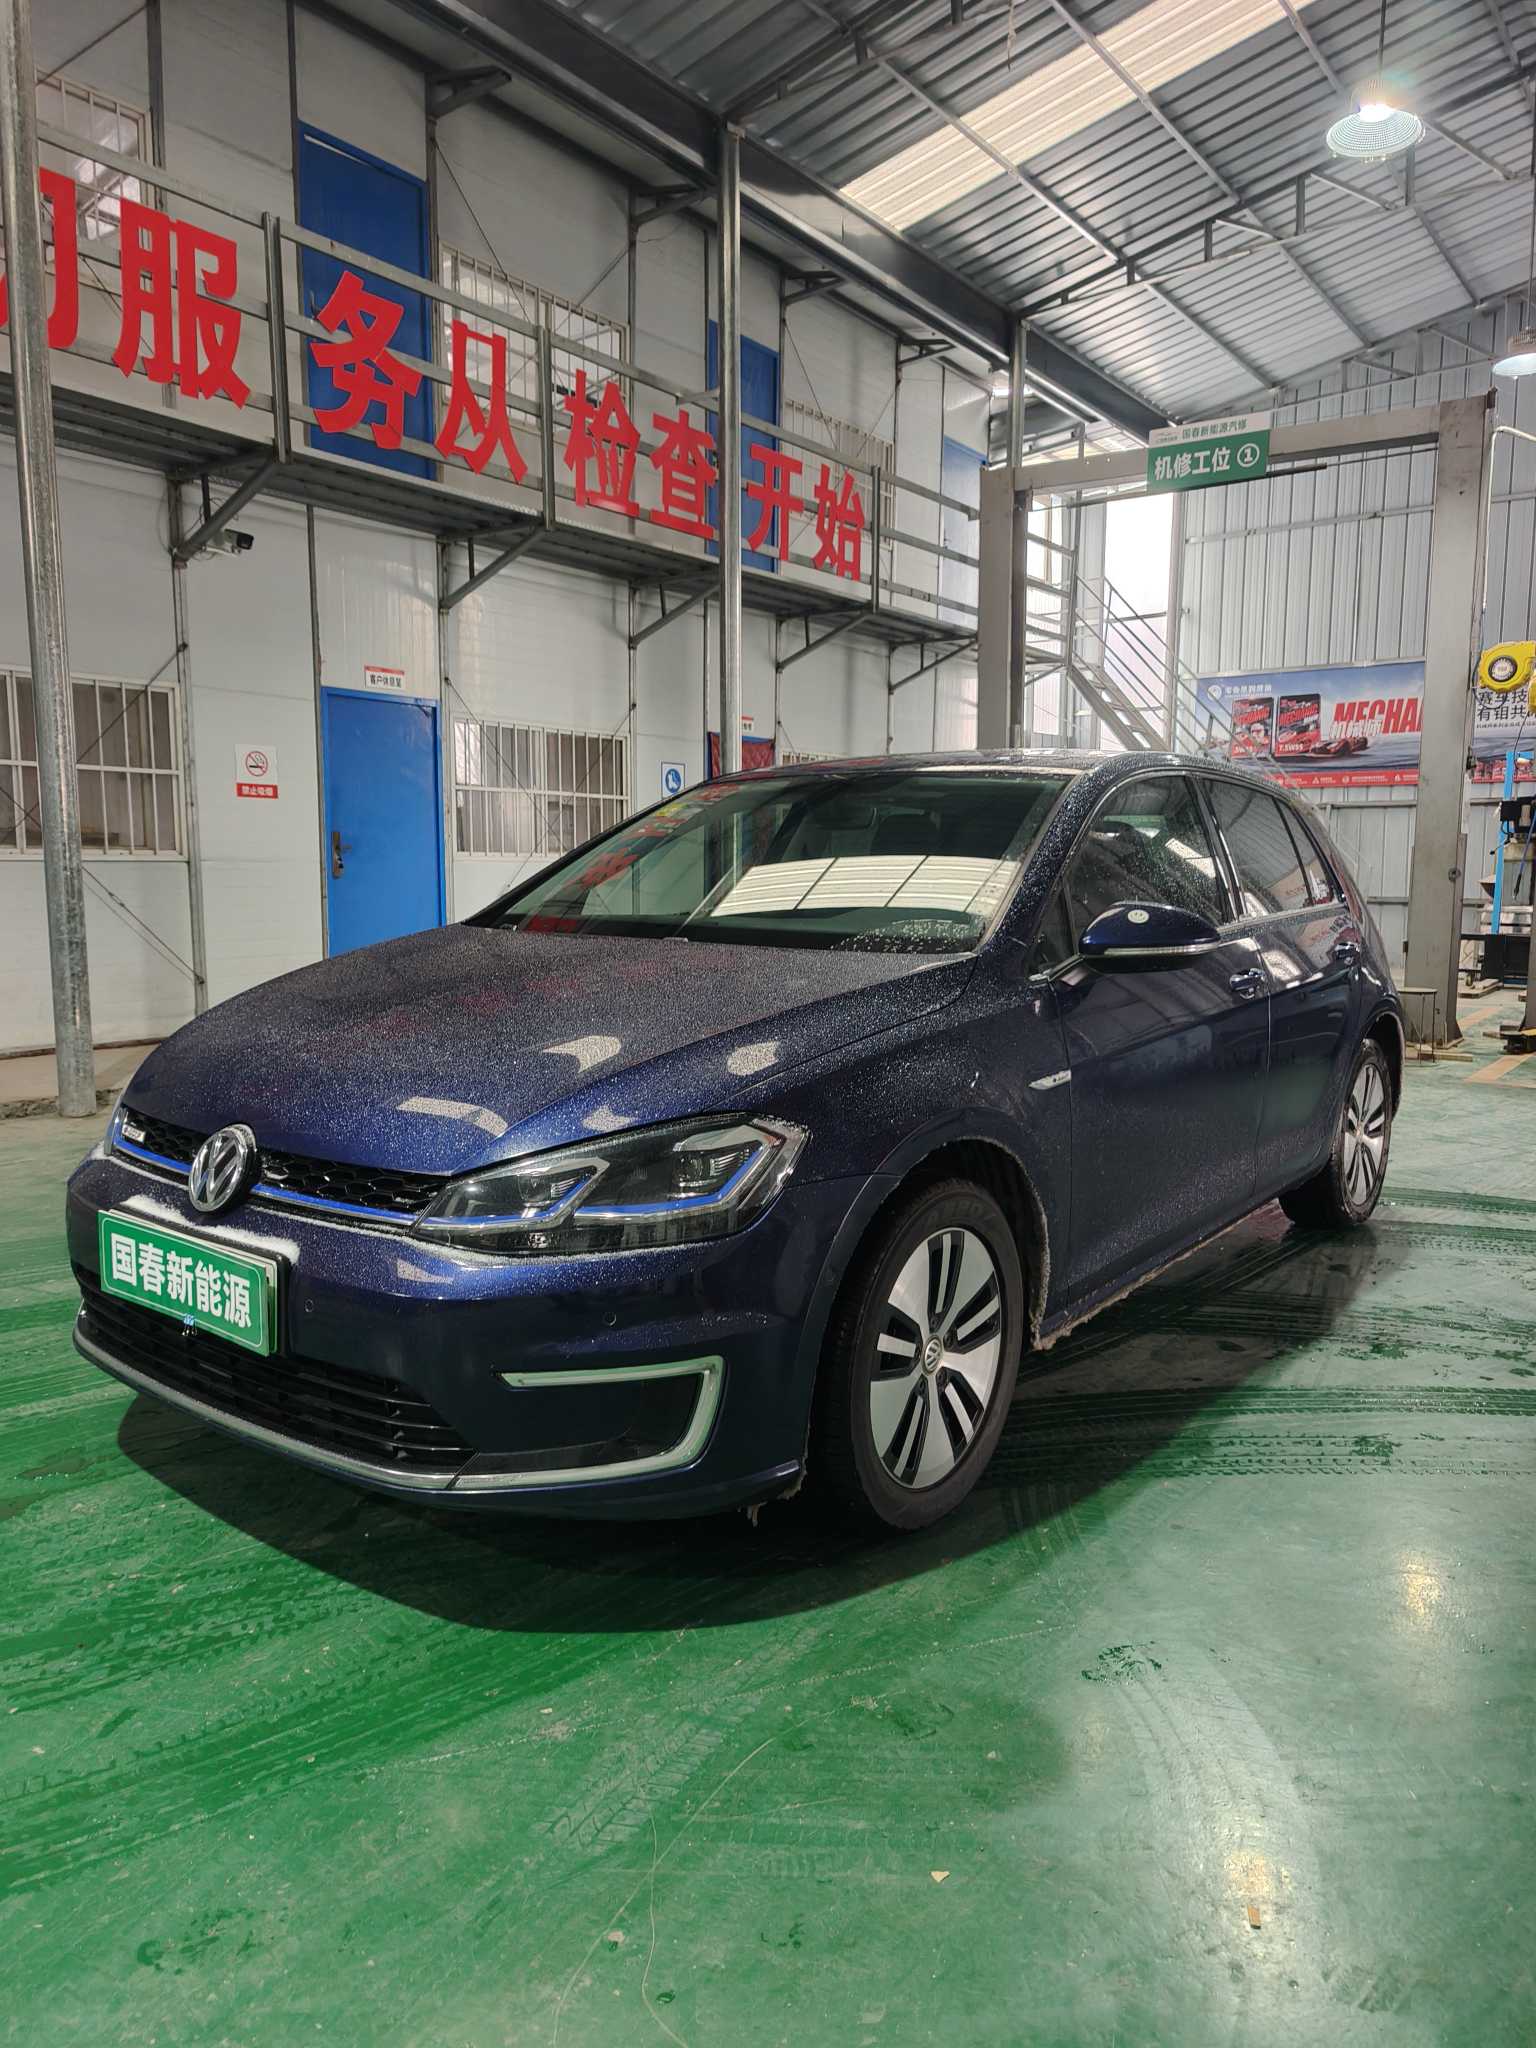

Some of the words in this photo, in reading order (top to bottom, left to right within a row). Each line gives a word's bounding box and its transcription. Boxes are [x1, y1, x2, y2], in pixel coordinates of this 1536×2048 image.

[1333, 697, 1424, 734] MECHA
[110, 1232, 252, 1328] 国春新能源
